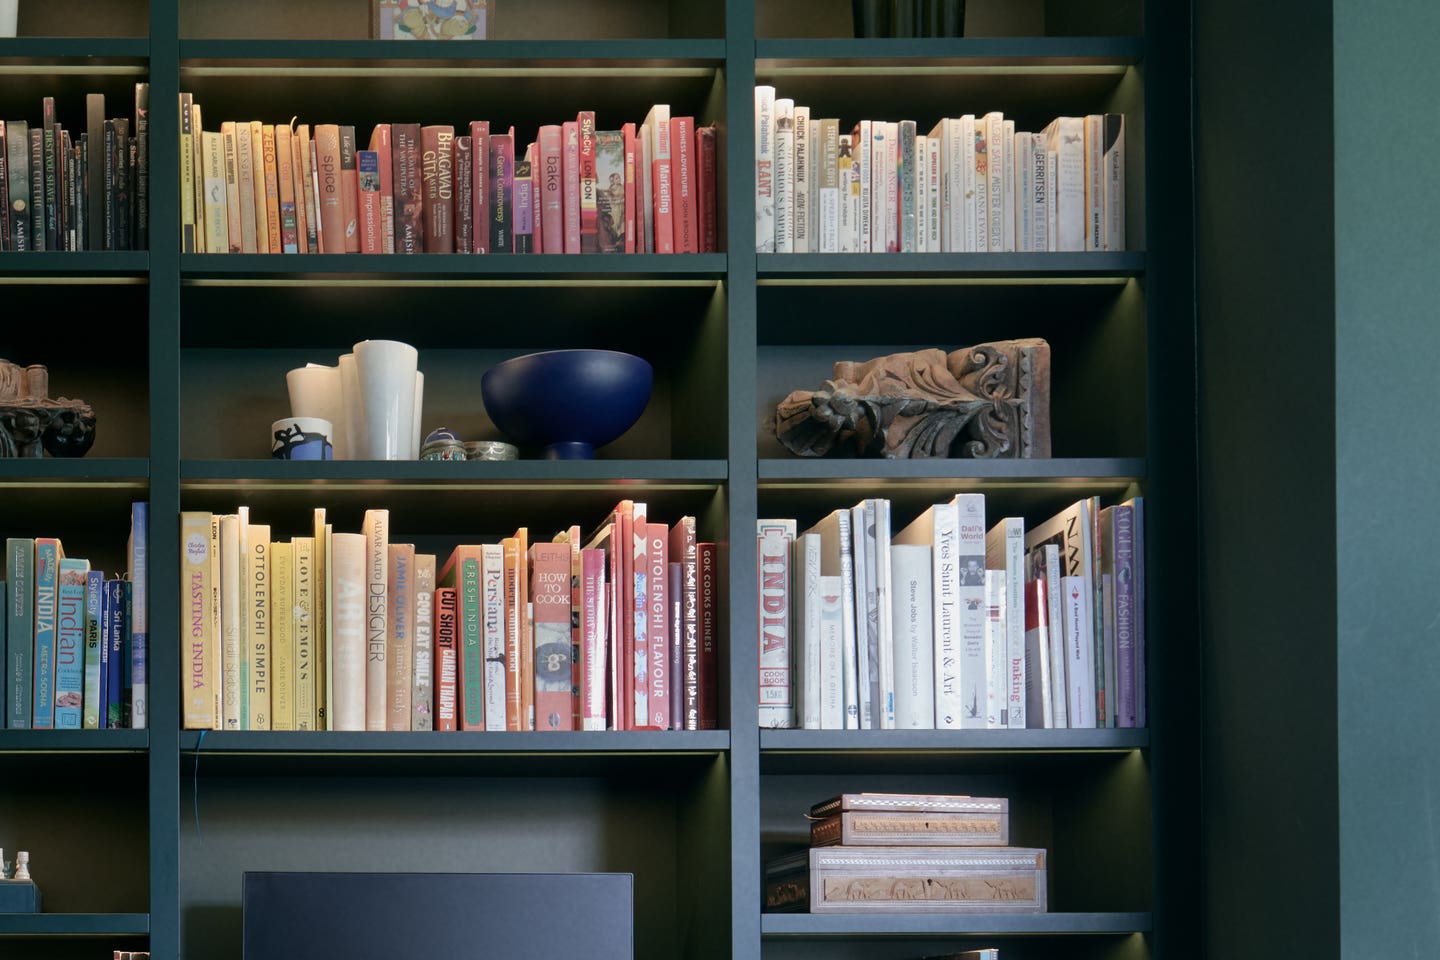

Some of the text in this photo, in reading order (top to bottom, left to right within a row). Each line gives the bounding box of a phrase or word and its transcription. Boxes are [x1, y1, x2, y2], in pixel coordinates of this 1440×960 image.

[407, 139, 415, 190] THE OATH OF
[437, 131, 453, 200] BHAGAVAD
[581, 118, 592, 200] StyleCity LONDON
[679, 121, 687, 153] BUSINESS
[796, 115, 805, 183] CHUCK PALAHNIUK
[281, 162, 291, 181] Goa
[321, 155, 337, 206] spice it
[399, 150, 408, 197] VAYUPUTRAS
[496, 143, 505, 223] The Great Controversy
[518, 184, 529, 208] India
[547, 156, 560, 210] bake it
[680, 153, 688, 197] ADVENTURES
[757, 160, 771, 198] RANT
[1035, 153, 1045, 204] GERRITSEN
[269, 210, 279, 251] PETER THIEL
[366, 193, 377, 251] Impressionism
[497, 229, 505, 247] WHITE
[977, 183, 986, 248] DIANA EVANS
[299, 556, 308, 597] LOVE
[369, 519, 386, 662] ALVAR AALTO DESIGNER
[467, 564, 477, 648] FRESH INDIA
[486, 569, 502, 634] Persiana
[536, 594, 570, 604] COOK
[539, 573, 567, 582] HOW
[544, 584, 561, 593] TO
[703, 550, 712, 653] GOK COOKS CHINESE
[762, 553, 786, 655] INDIA
[1117, 509, 1131, 649] VOGUE FASHION
[59, 595, 84, 665] Indian
[88, 577, 98, 649] StyleCity PARIS
[113, 610, 121, 651] Sri Lanka
[191, 571, 204, 690] TASTING INDIA
[255, 544, 266, 694] OTTOLENGHI SIMPLE
[417, 591, 431, 688] COOK EAT SMILE
[652, 539, 664, 698] OTTOLENGHI FLAVOUR
[909, 580, 919, 697] Steve Jobs by Walter Isaacson
[940, 530, 955, 696] Yves Saint Laurent & Art
[37, 585, 54, 708] INDIA MEERA SODHA
[299, 613, 309, 681] LEMONS
[438, 590, 456, 719] CUT SHORT CIARAN THAPAR
[1010, 658, 1022, 703] baking
